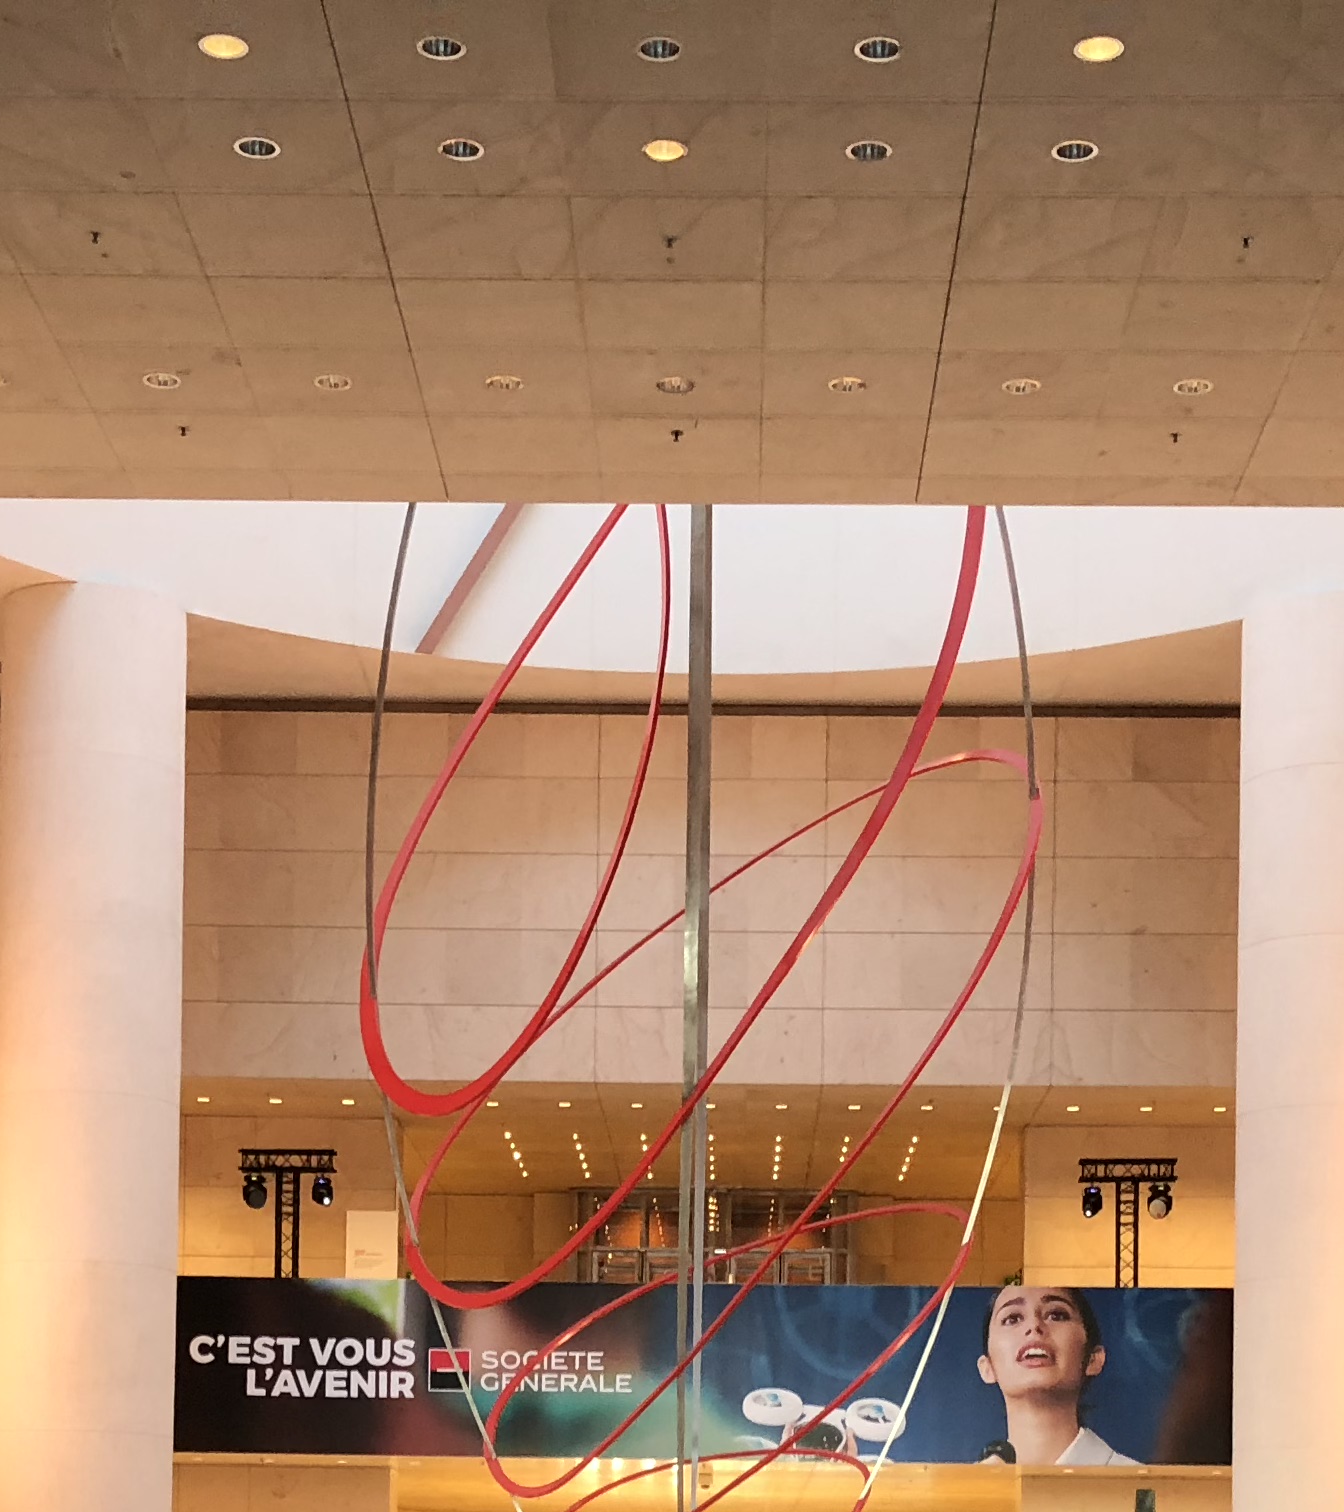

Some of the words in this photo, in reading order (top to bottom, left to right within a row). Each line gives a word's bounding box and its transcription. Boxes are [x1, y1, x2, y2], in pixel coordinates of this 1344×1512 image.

[189, 1336, 300, 1366] C'EST
[308, 1338, 415, 1367] VOUS
[481, 1350, 604, 1371] SOCIETE
[246, 1369, 415, 1399] L'AVENIR
[480, 1372, 633, 1393] GENERALE
